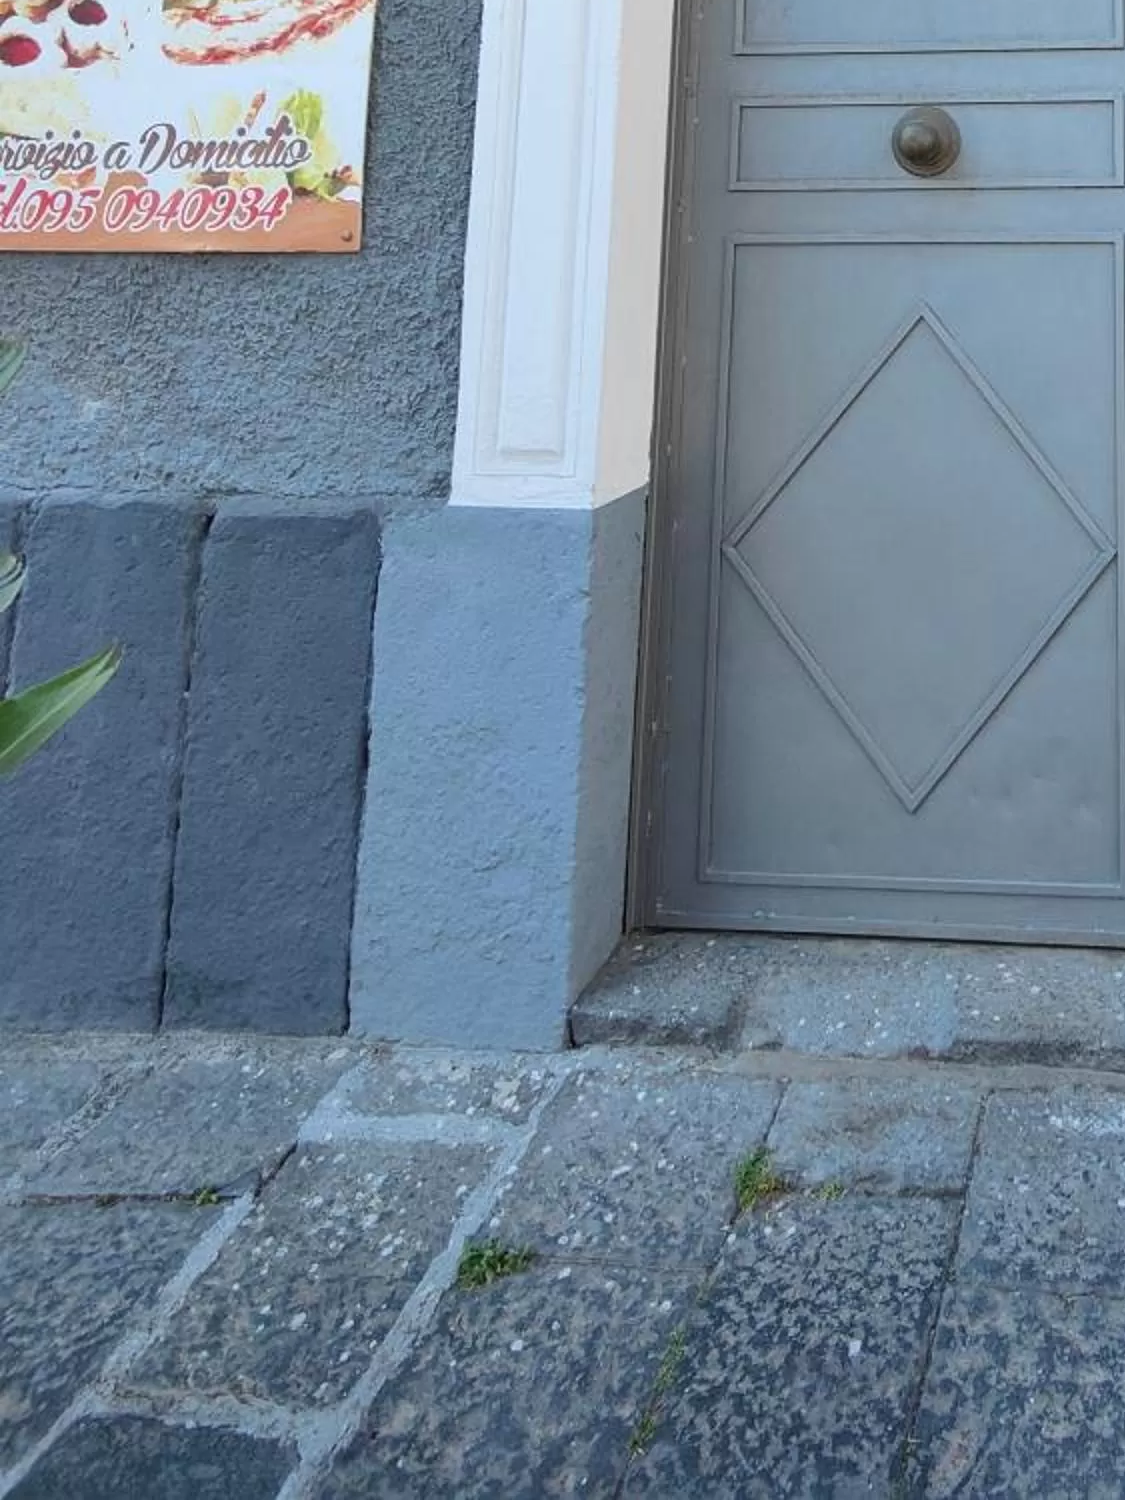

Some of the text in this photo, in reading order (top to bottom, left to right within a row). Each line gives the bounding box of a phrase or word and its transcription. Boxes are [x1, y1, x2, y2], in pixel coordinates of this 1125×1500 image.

[0, 114, 312, 180] rvizio a Domicilio
[104, 186, 292, 232] 0940934
